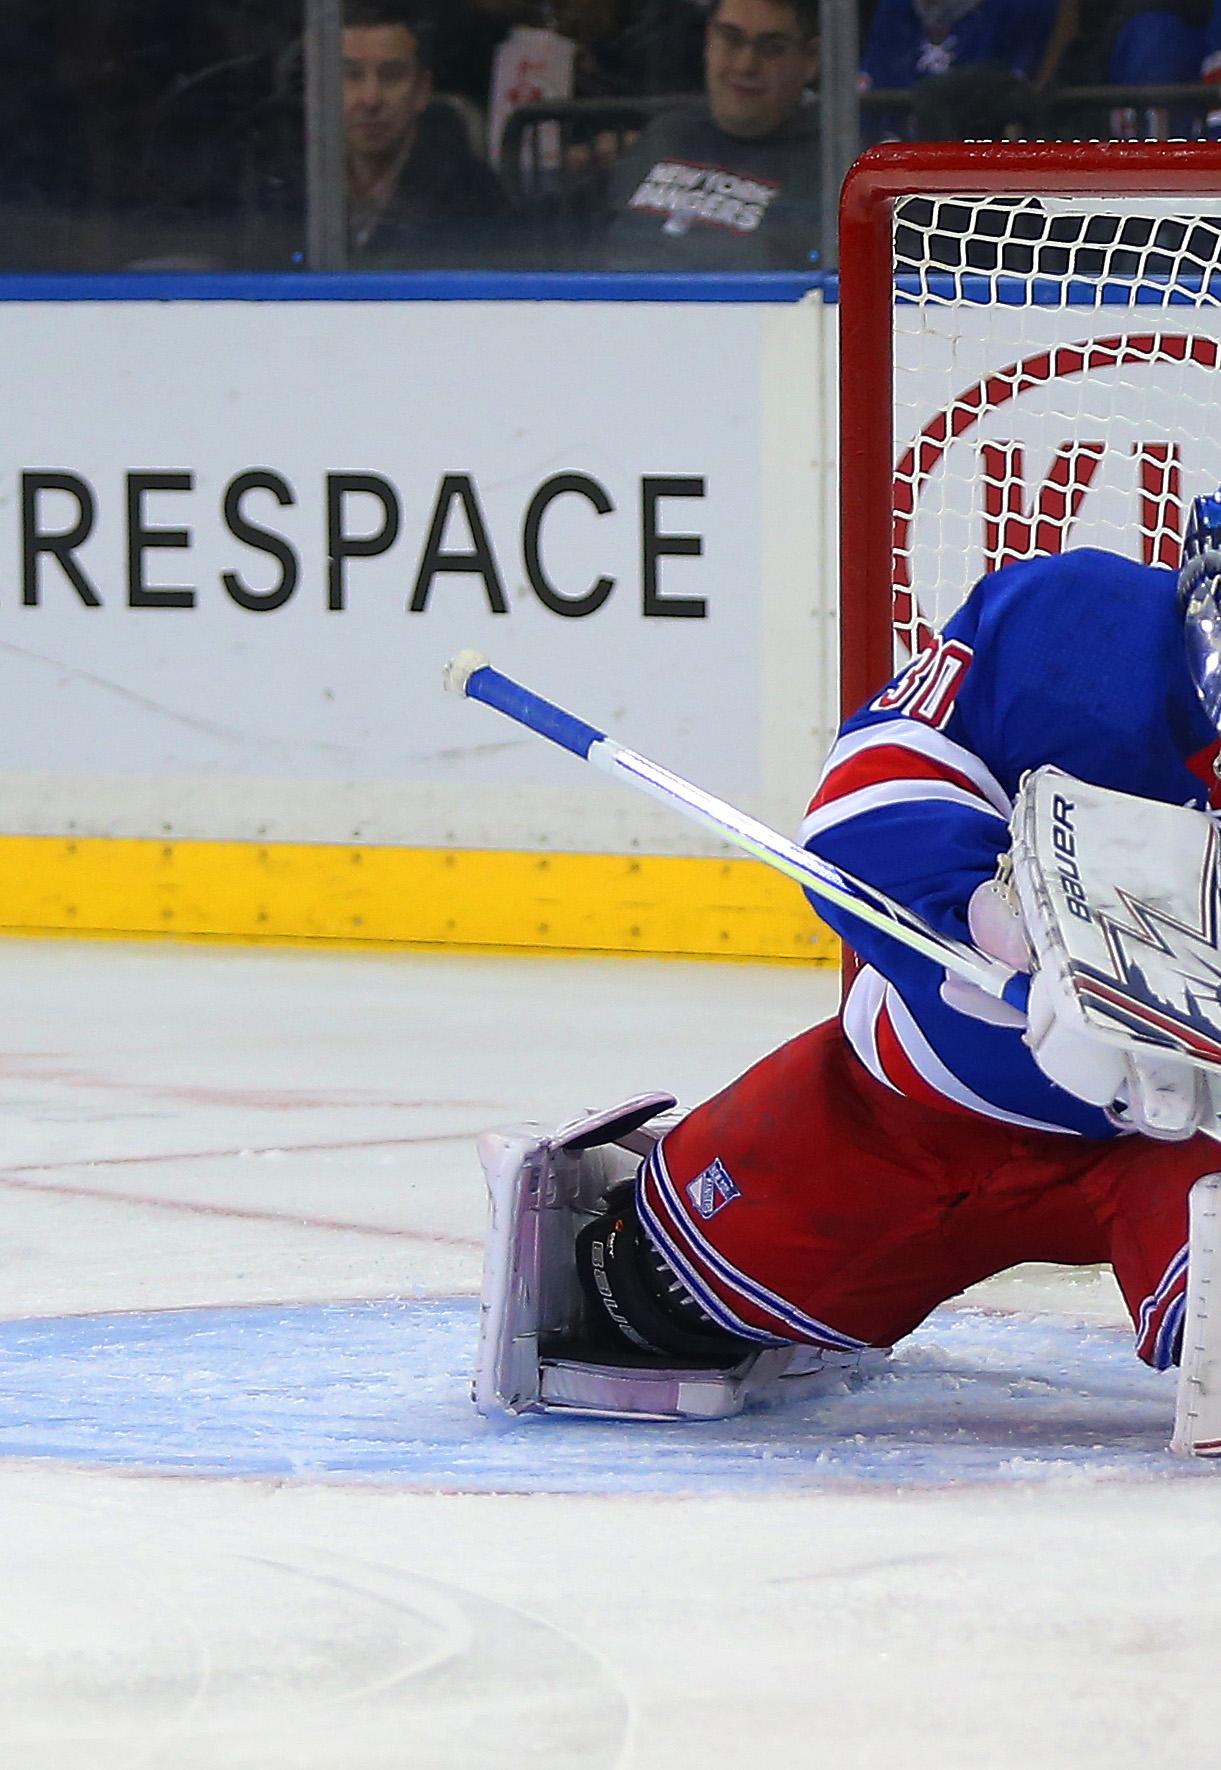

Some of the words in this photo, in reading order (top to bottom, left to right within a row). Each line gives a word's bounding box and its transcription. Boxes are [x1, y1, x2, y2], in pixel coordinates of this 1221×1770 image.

[22, 468, 709, 619] RESPACE
[868, 634, 975, 731] 30
[1053, 793, 1093, 924] BAUER
